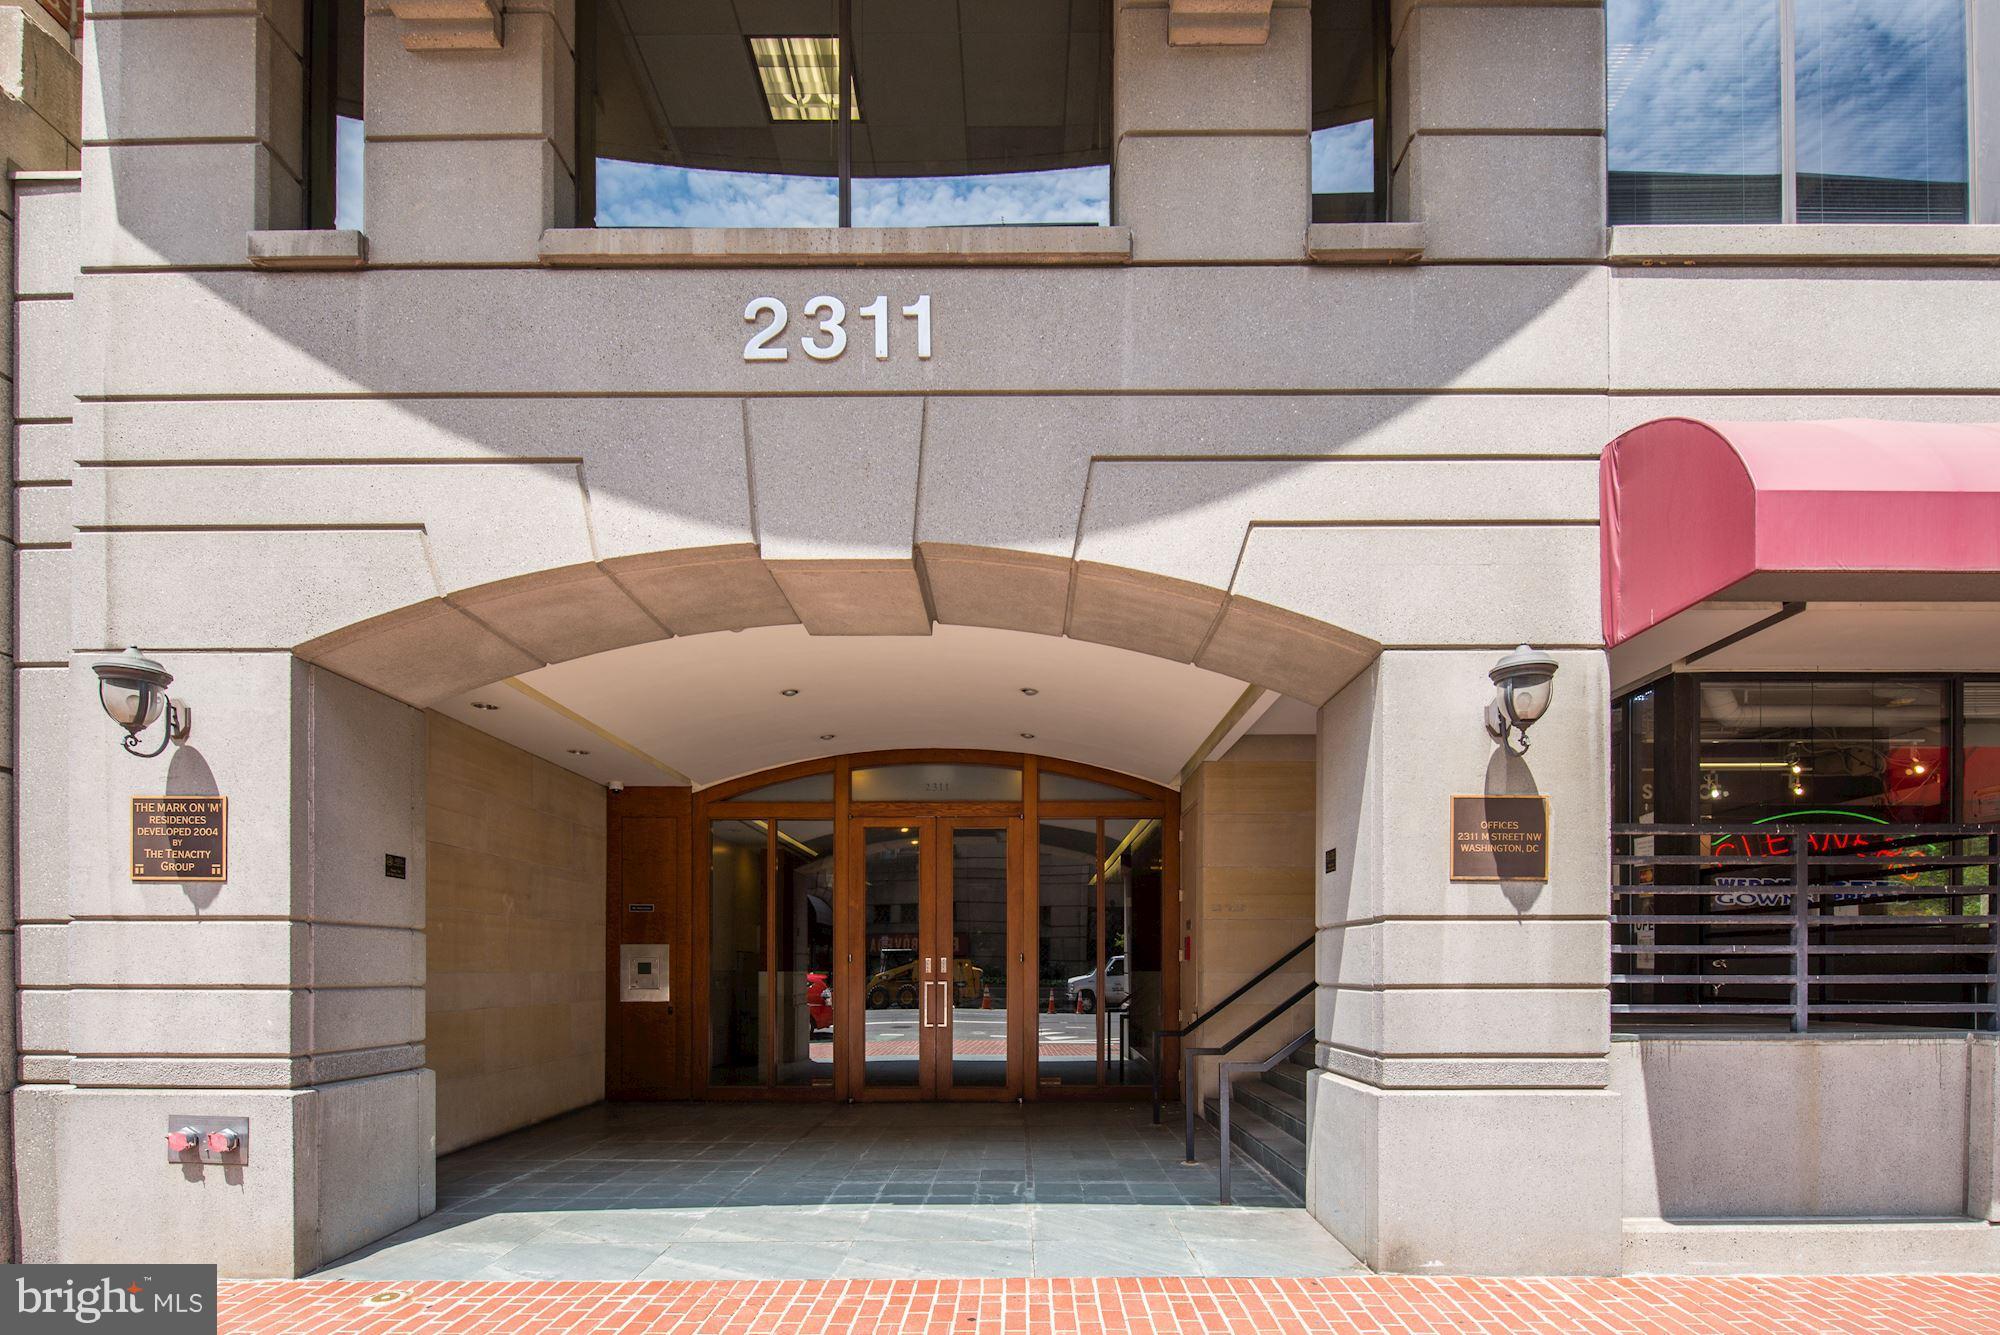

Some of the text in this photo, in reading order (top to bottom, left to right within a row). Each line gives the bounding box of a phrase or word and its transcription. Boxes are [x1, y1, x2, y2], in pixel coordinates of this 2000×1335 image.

[743, 295, 931, 361] 2311
[134, 803, 222, 813] THE MARK ON 'M'
[149, 816, 207, 825] RESIDENCES
[1480, 821, 1519, 830] OFFICES
[137, 827, 219, 836] DEVELOPED 2004
[1457, 832, 1542, 841] 2311 M STREET NW
[172, 839, 183, 847] BY
[1460, 844, 1540, 853] WASHINGTON, DC
[144, 848, 211, 859] THE TENACITY
[160, 861, 195, 871] GROUP
